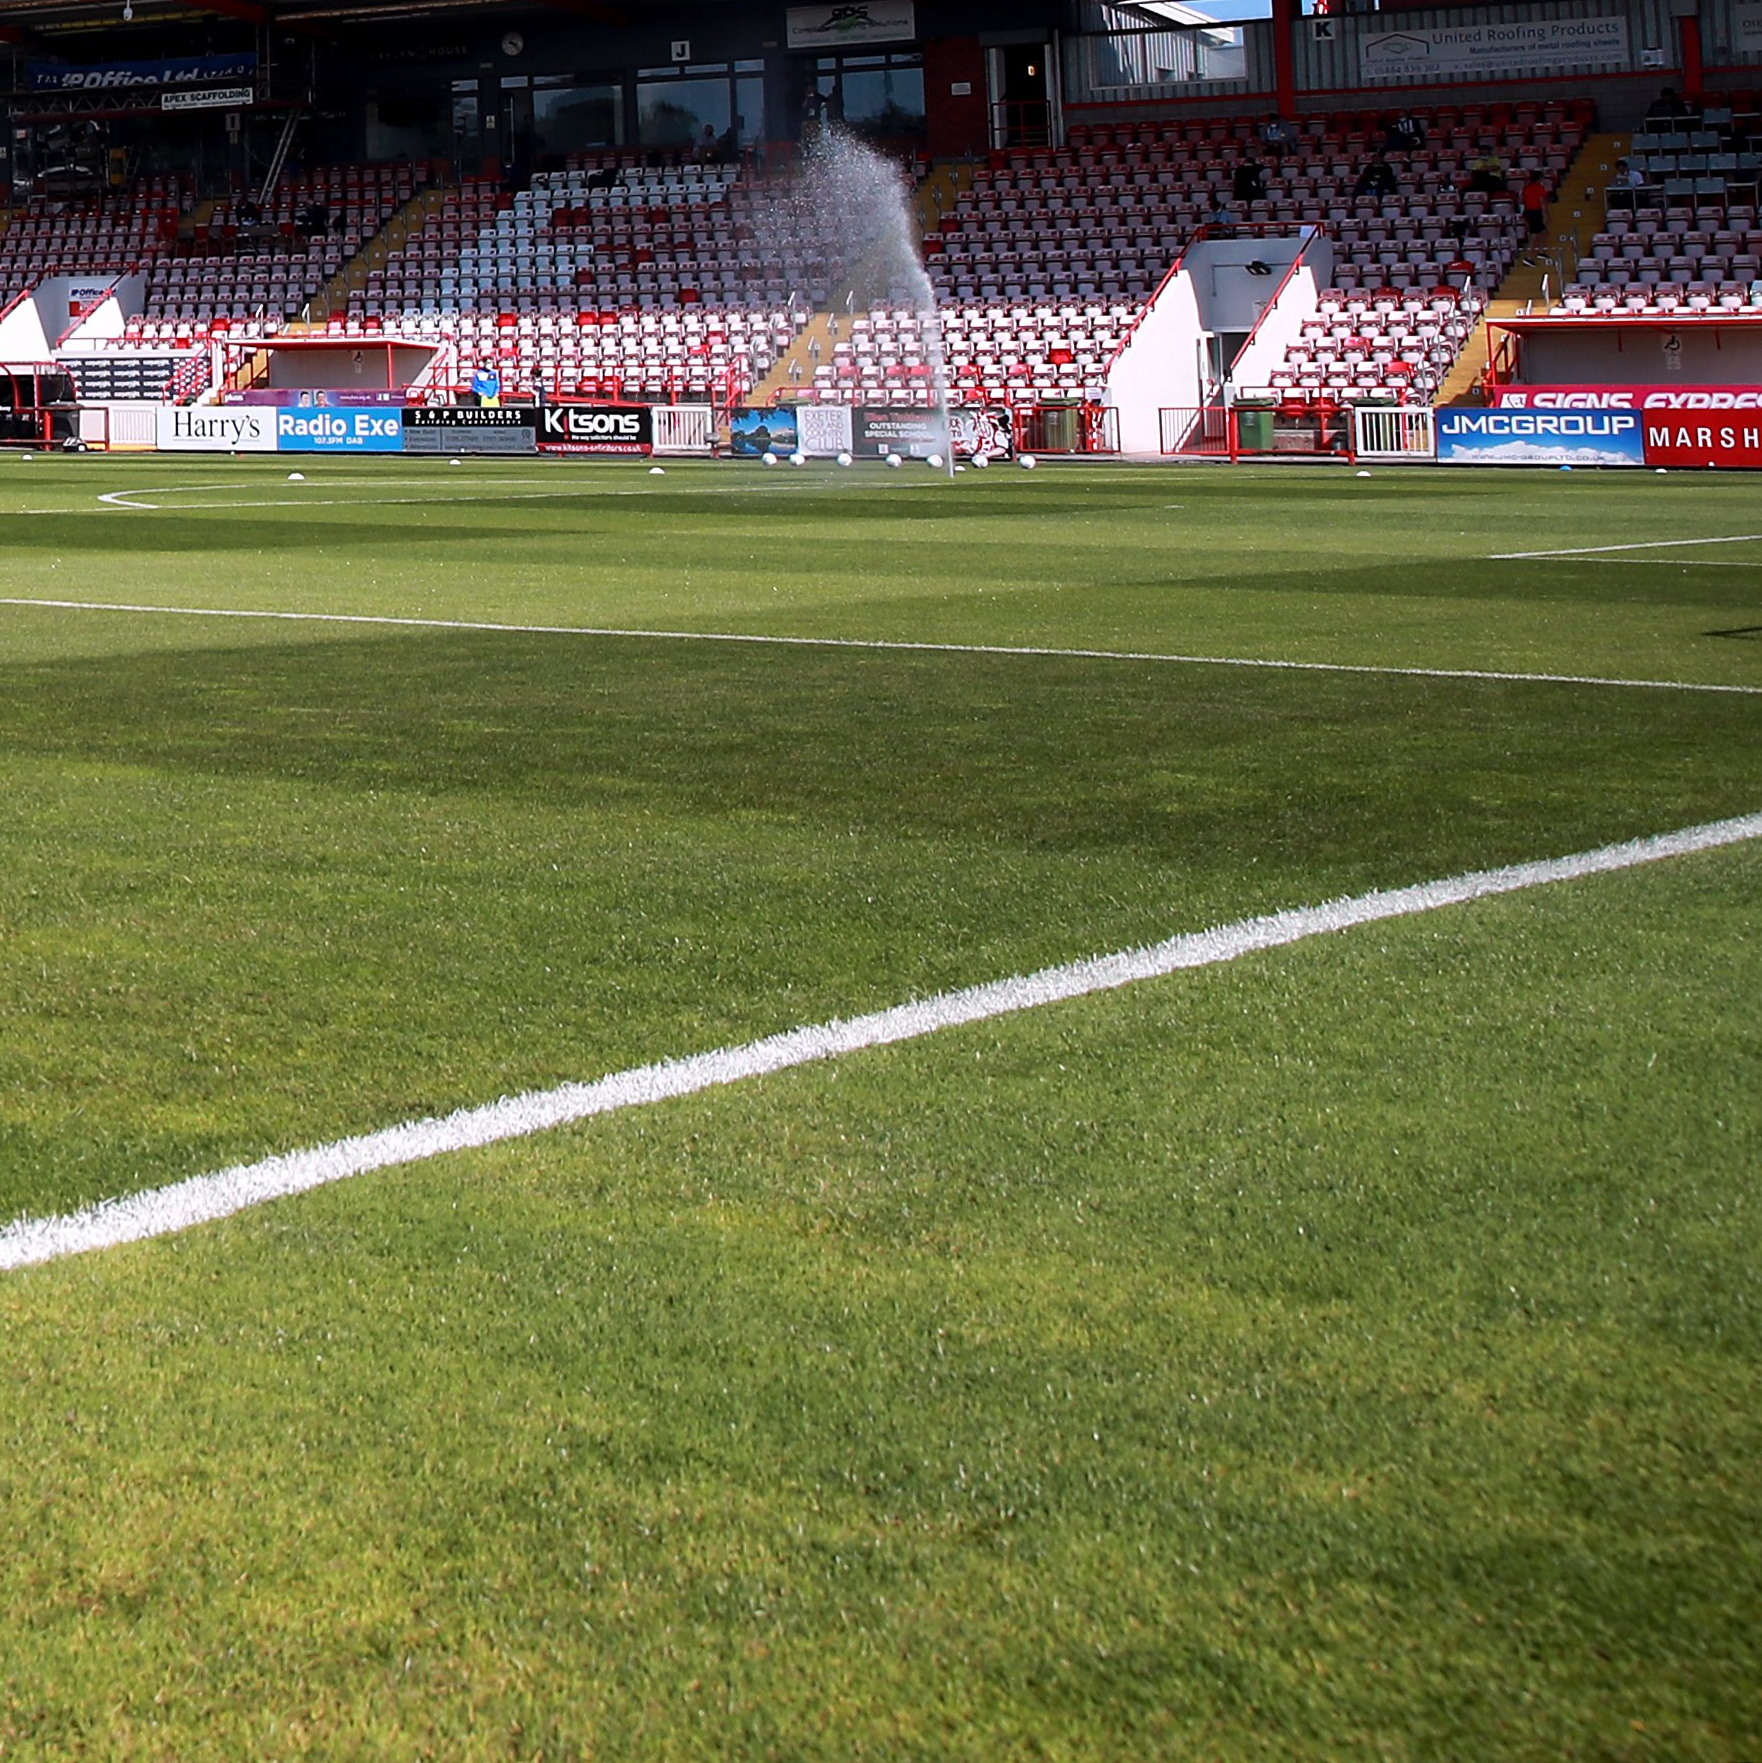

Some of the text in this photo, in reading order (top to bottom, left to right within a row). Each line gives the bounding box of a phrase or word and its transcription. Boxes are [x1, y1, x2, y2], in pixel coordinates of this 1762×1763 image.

[1316, 22, 1332, 37] K
[1432, 21, 1619, 45] United Roofing Products
[676, 44, 685, 57] J
[163, 88, 251, 104] APEX SCAFFOLDING
[1533, 392, 1762, 409] SIGNS EXPRE
[442, 411, 450, 419] P
[456, 410, 522, 419] BUILDERS
[544, 408, 641, 436] Kitsons
[804, 410, 843, 421] EXETER
[174, 411, 261, 445] Harry's
[279, 414, 399, 436] Radio Exe
[869, 422, 927, 430] OUTSTANDING
[1441, 415, 1635, 435] JMCGROUP
[346, 437, 363, 445] DAB
[864, 430, 898, 438] SPECIAL
[1649, 426, 1759, 449] MARSH
[804, 438, 844, 451] CLUB
